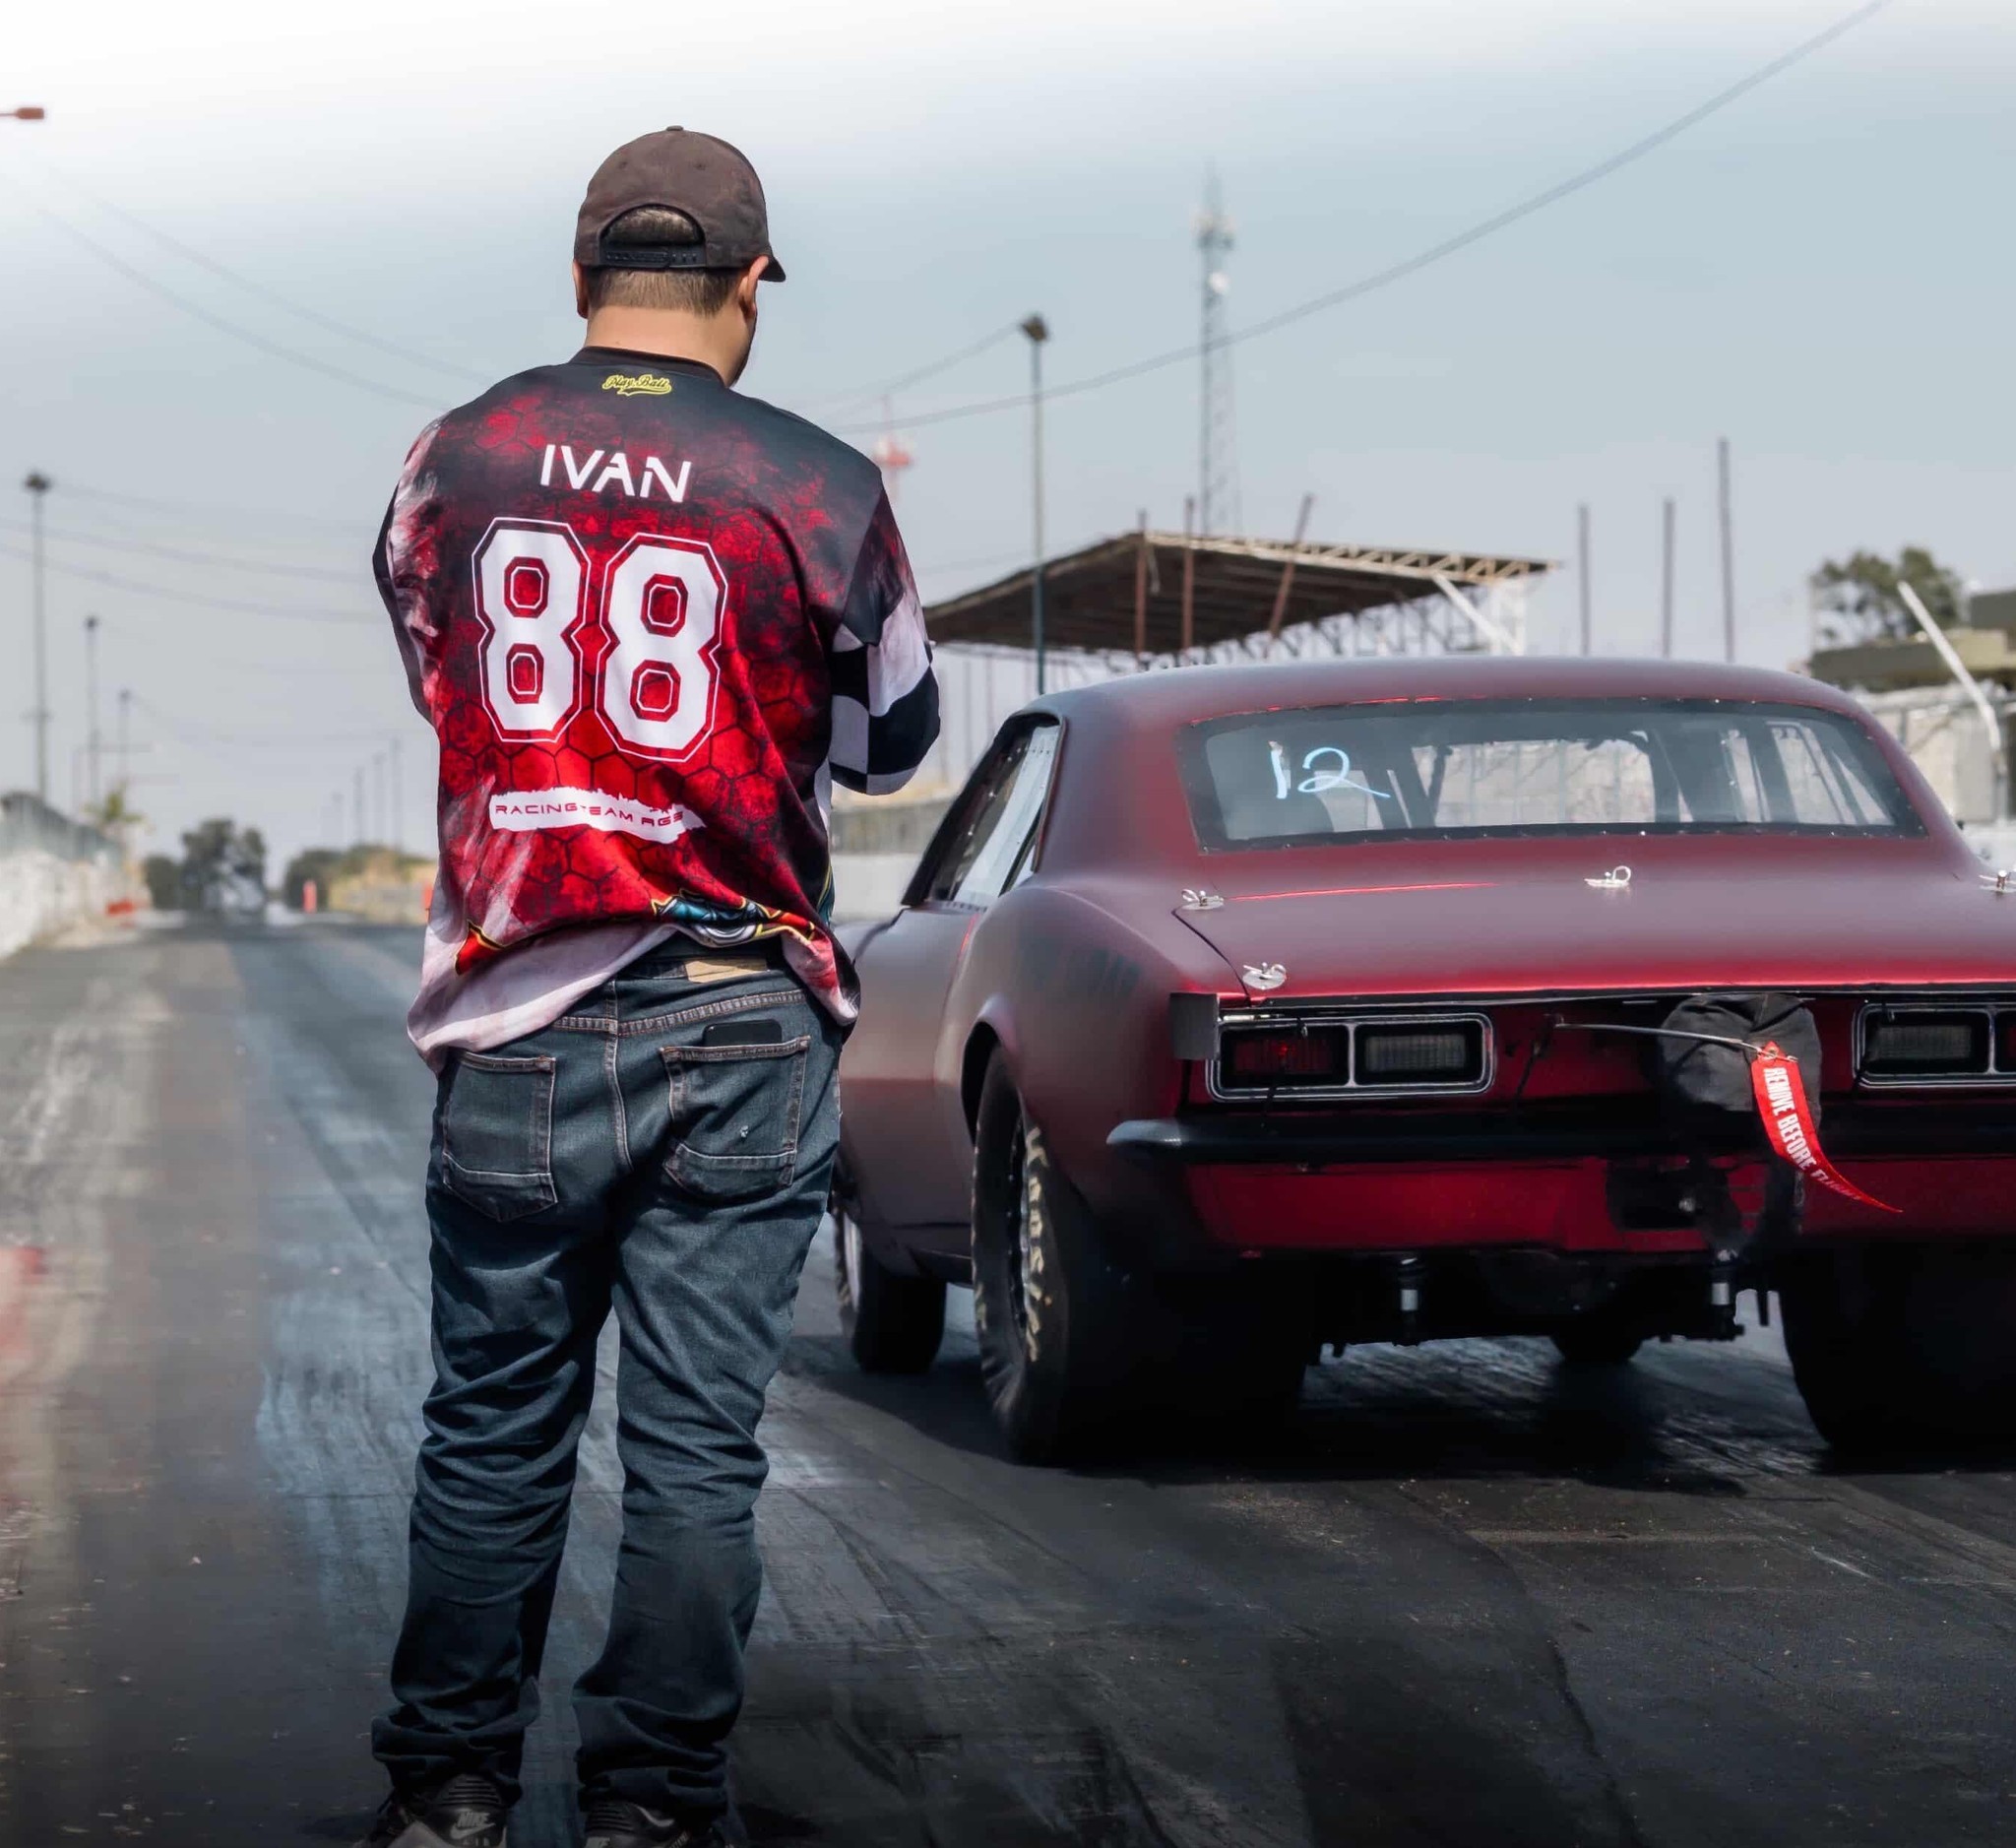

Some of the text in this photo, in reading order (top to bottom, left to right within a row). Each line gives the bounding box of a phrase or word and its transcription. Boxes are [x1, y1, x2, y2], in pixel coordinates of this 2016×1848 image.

[540, 443, 692, 503] IVAN
[472, 517, 728, 762] 88
[1268, 742, 1391, 798] 12
[495, 802, 578, 815] RACING
[580, 805, 633, 822] EAM
[1763, 1067, 1796, 1116] REMOVE
[1777, 1114, 1817, 1170] BEFORE
